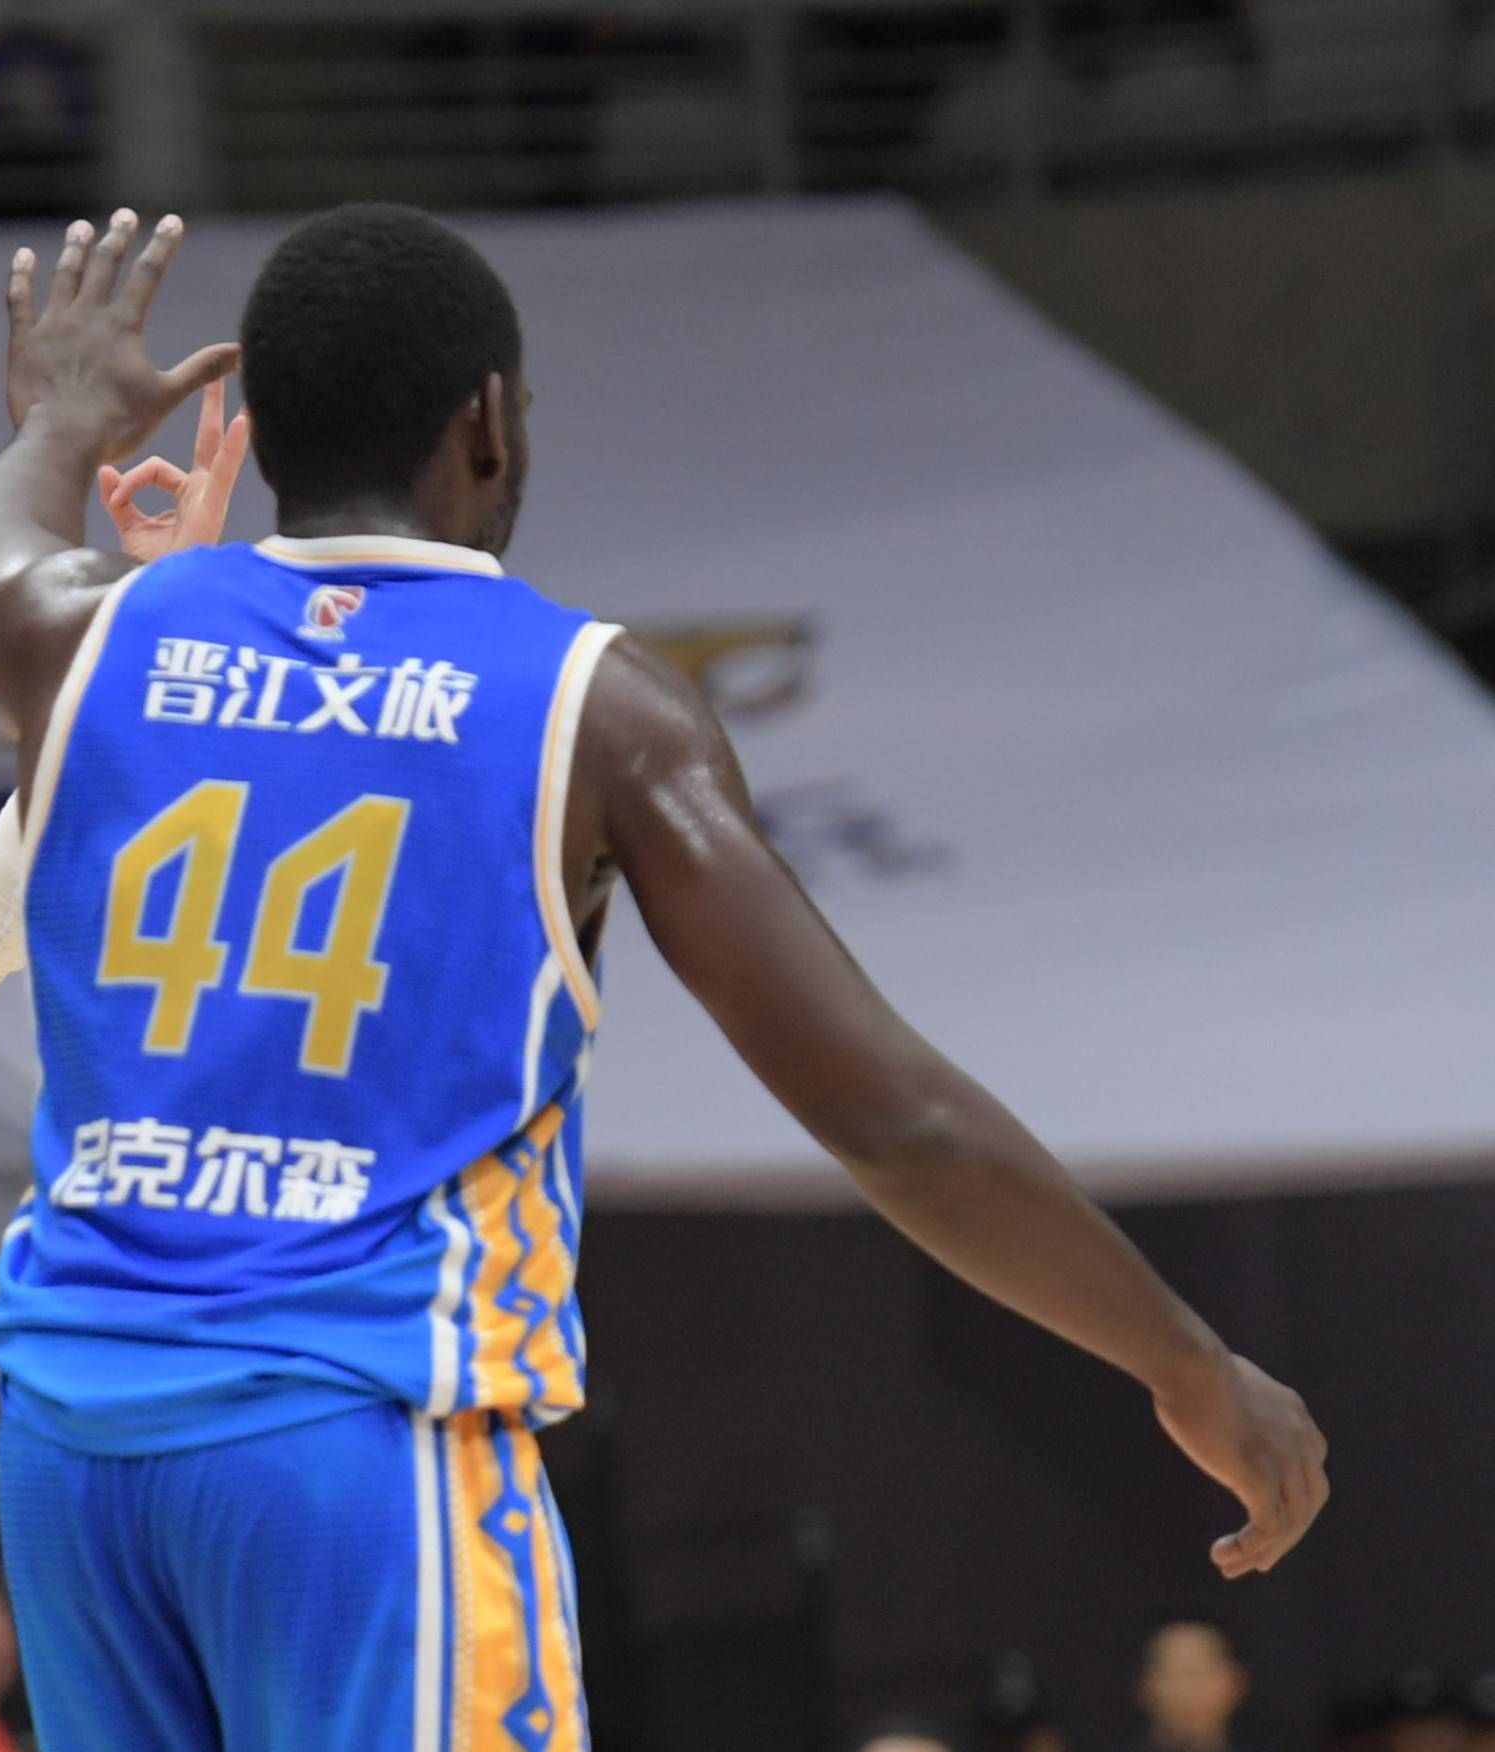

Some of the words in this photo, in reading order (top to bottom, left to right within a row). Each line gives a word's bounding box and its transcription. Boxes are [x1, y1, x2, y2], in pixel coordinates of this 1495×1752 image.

[142, 637, 479, 745] 晋江文旅
[96, 778, 411, 1080] 44
